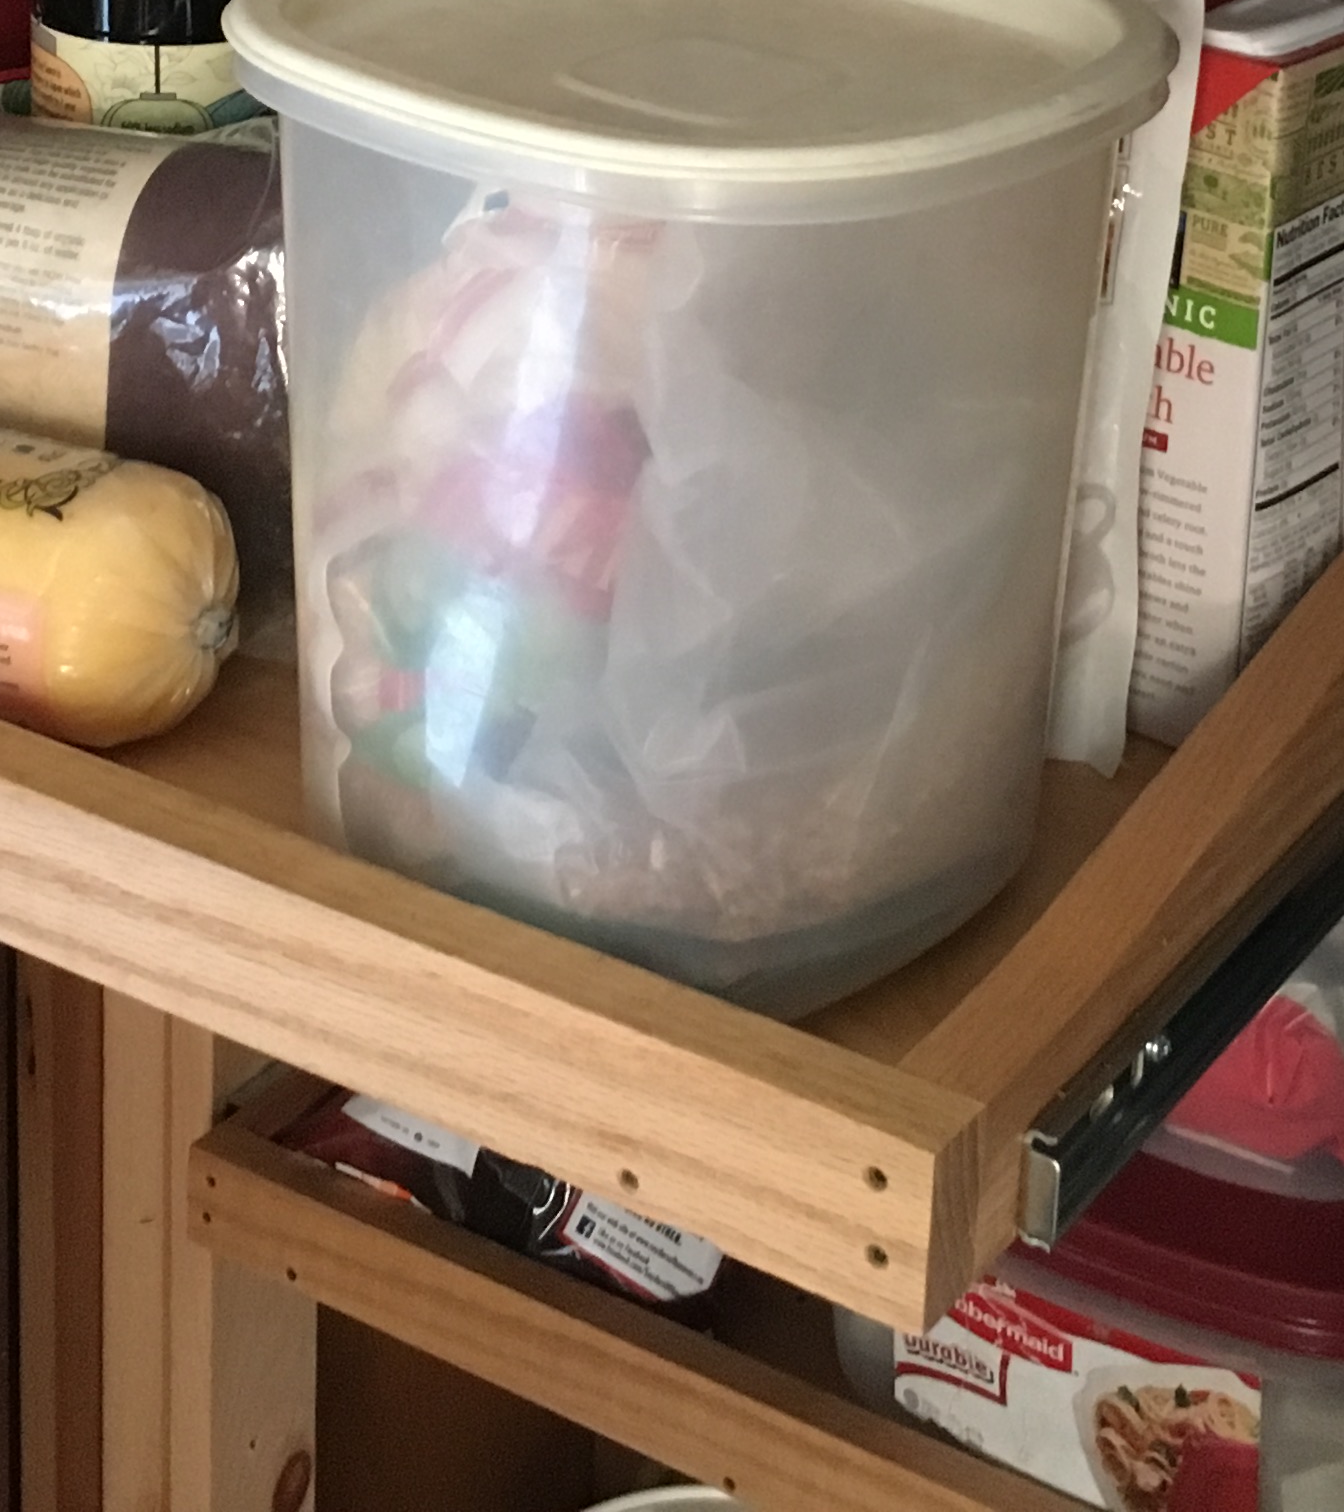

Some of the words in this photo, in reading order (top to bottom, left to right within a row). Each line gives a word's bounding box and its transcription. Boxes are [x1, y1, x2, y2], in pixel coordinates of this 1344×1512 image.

[1191, 214, 1229, 238] PURE
[1276, 213, 1320, 248] Nutrition
[955, 1298, 1064, 1363] bbermaid
